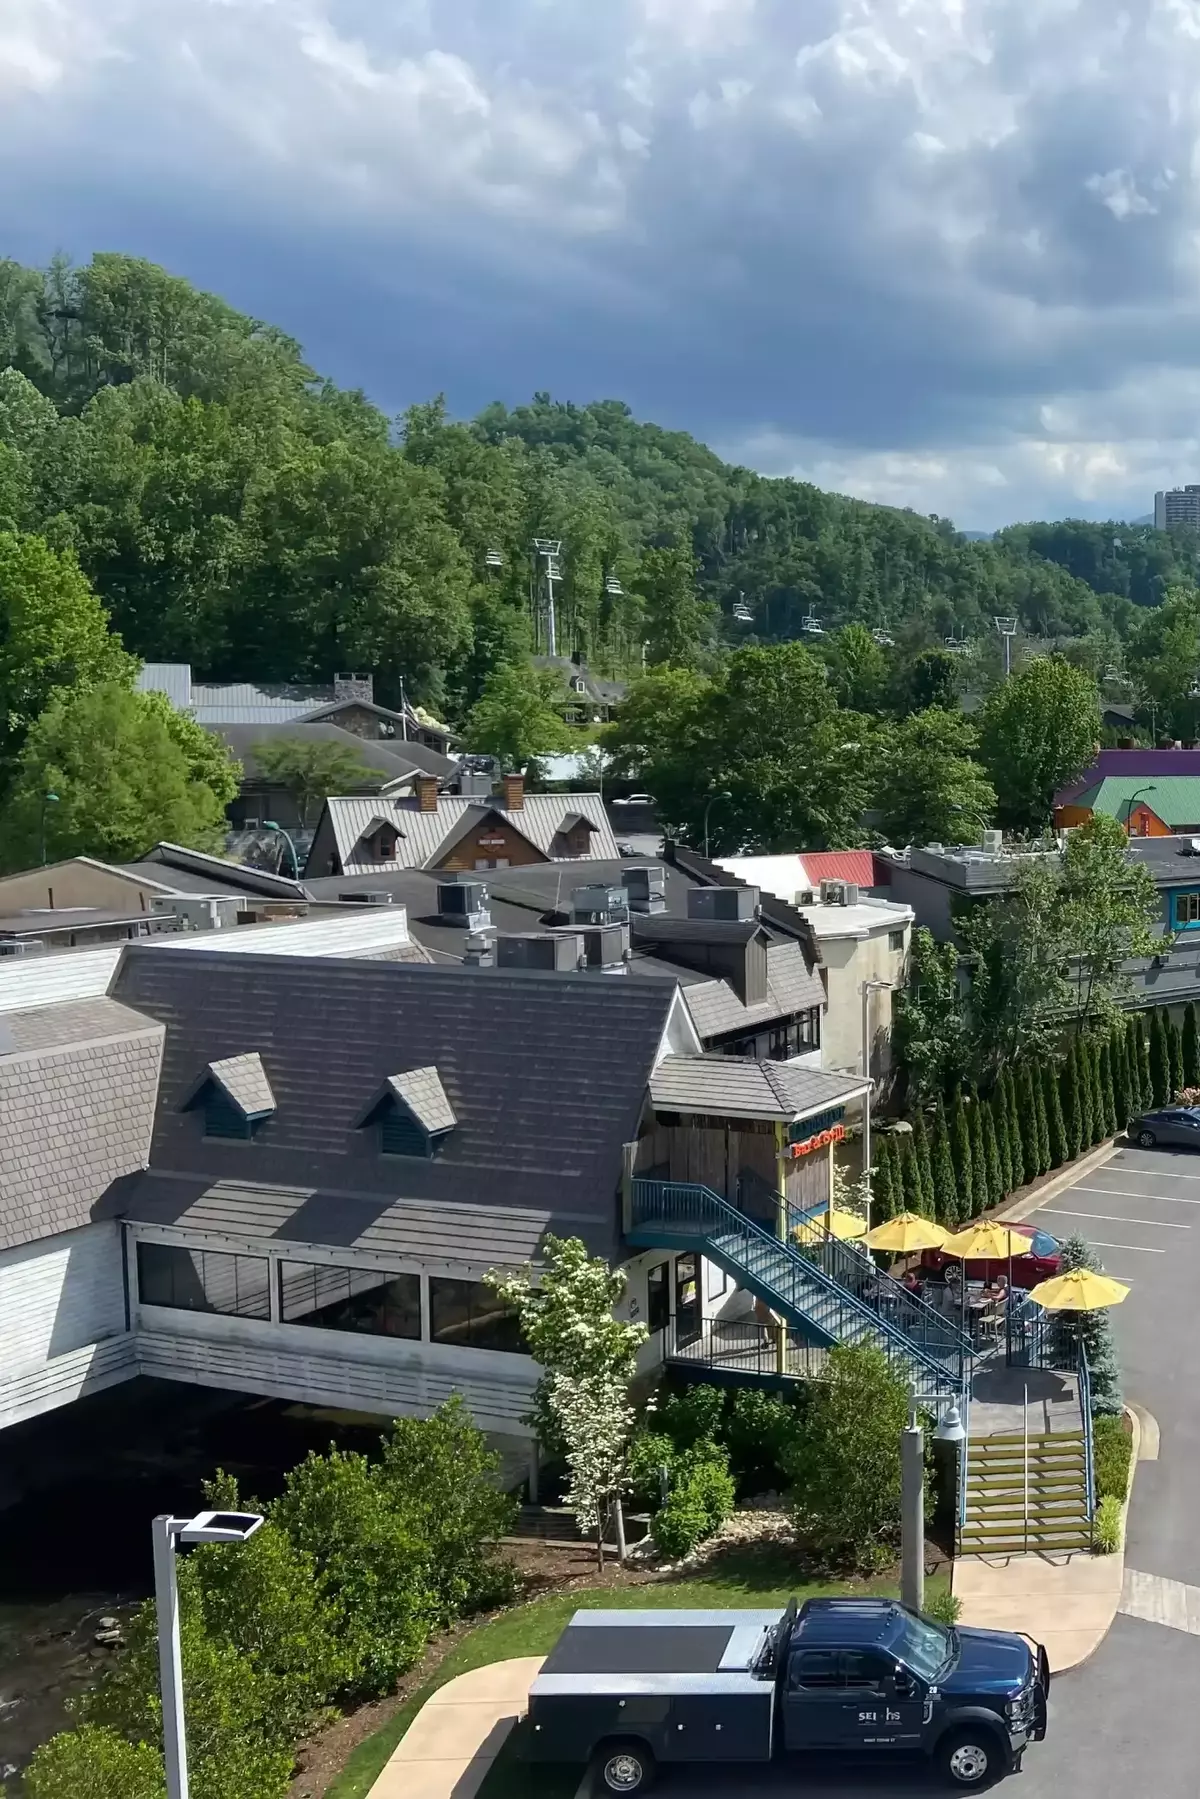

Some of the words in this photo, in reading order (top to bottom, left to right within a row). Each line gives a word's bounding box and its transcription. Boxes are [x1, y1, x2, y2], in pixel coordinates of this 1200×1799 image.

[791, 1142, 811, 1158] Bar
[819, 1123, 845, 1147] Grill
[858, 1712, 877, 1721] SEI
